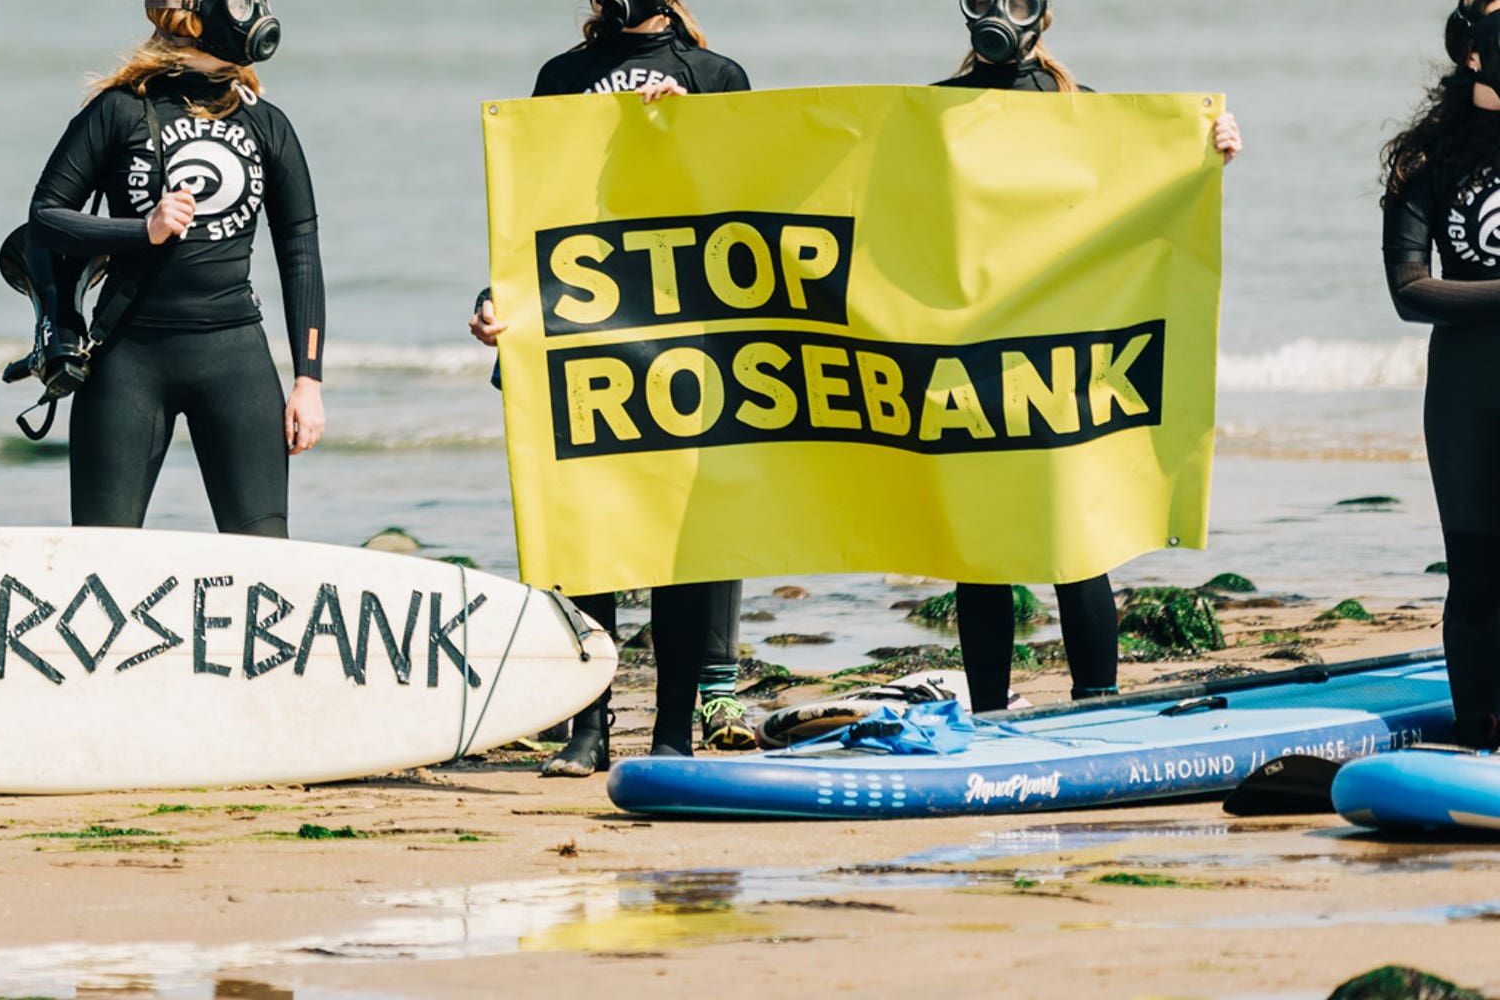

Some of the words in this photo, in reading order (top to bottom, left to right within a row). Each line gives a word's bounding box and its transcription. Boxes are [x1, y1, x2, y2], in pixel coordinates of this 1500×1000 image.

[207, 166, 265, 242] SEWAGE
[549, 222, 840, 324] STOP
[564, 332, 1150, 445] ROSEBANK
[1129, 755, 1235, 785] ALLROUND
[1389, 729, 1423, 750] TEN
